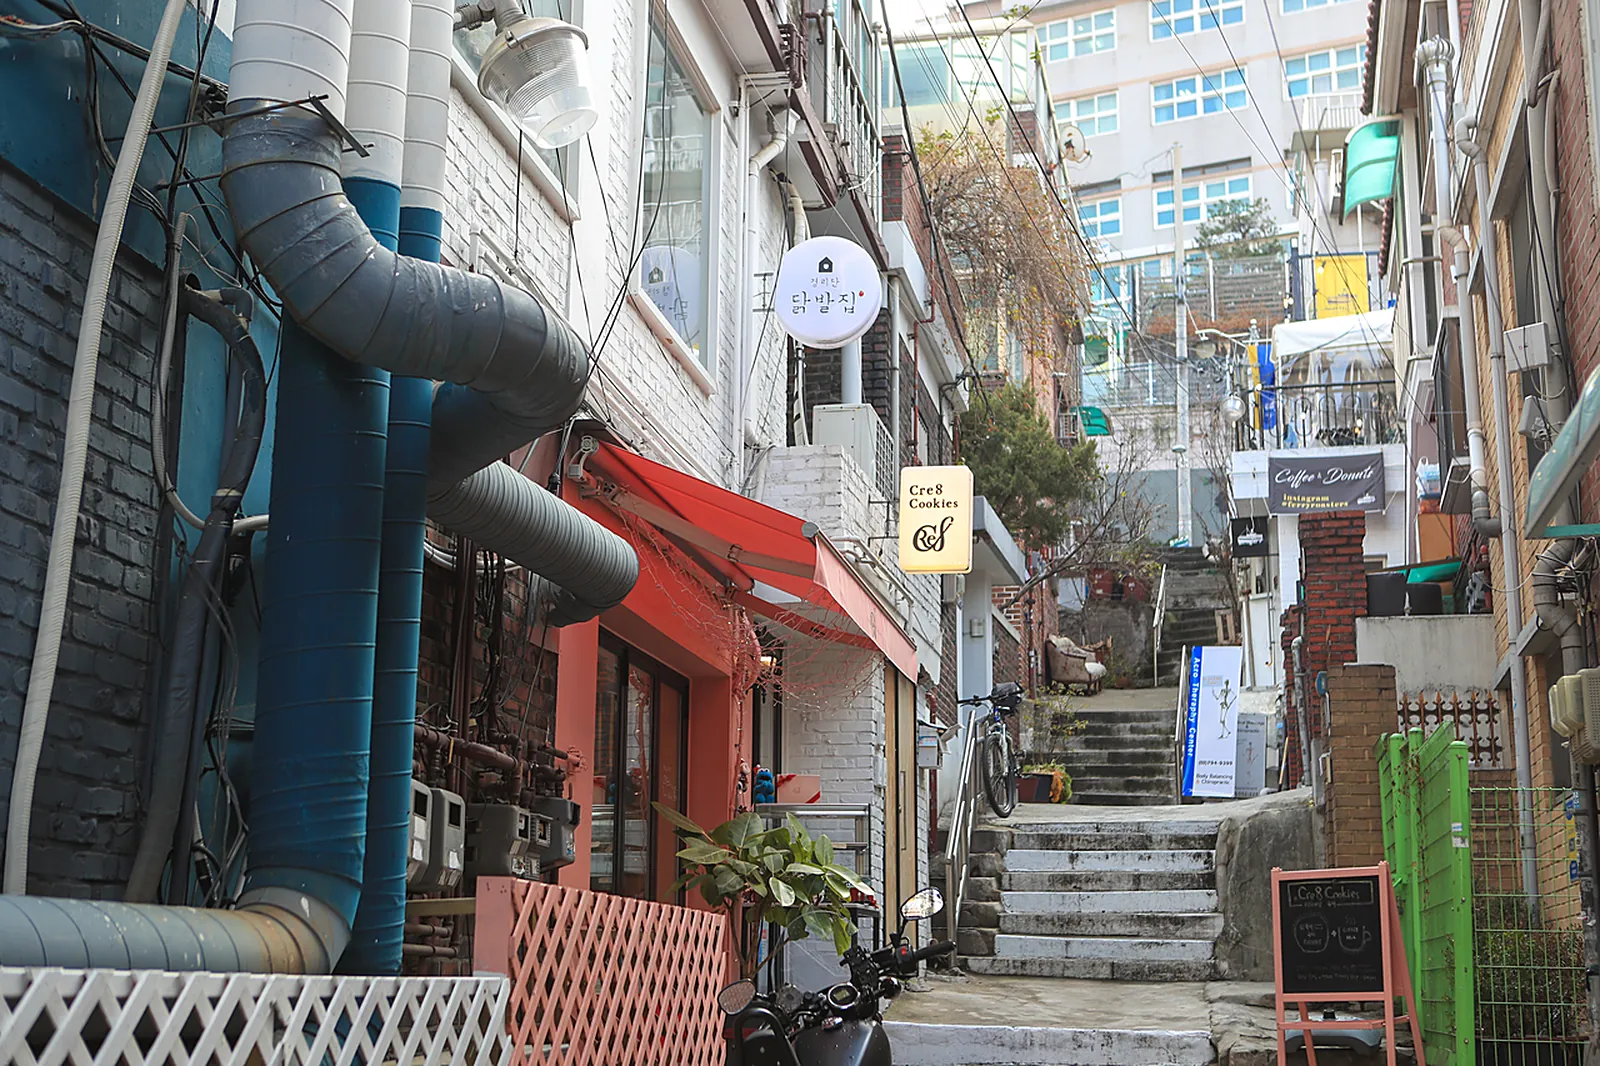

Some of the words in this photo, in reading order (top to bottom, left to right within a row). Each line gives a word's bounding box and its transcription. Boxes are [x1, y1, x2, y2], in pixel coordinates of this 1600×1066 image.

[1275, 468, 1315, 488] Coffee
[1322, 466, 1374, 485] Donuts
[909, 483, 943, 496] Cre8
[909, 498, 959, 510] Cookies
[1283, 493, 1330, 502] Instagram
[1192, 657, 1201, 678] Acro
[1187, 727, 1196, 757] Center
[1298, 886, 1322, 900] Cre8
